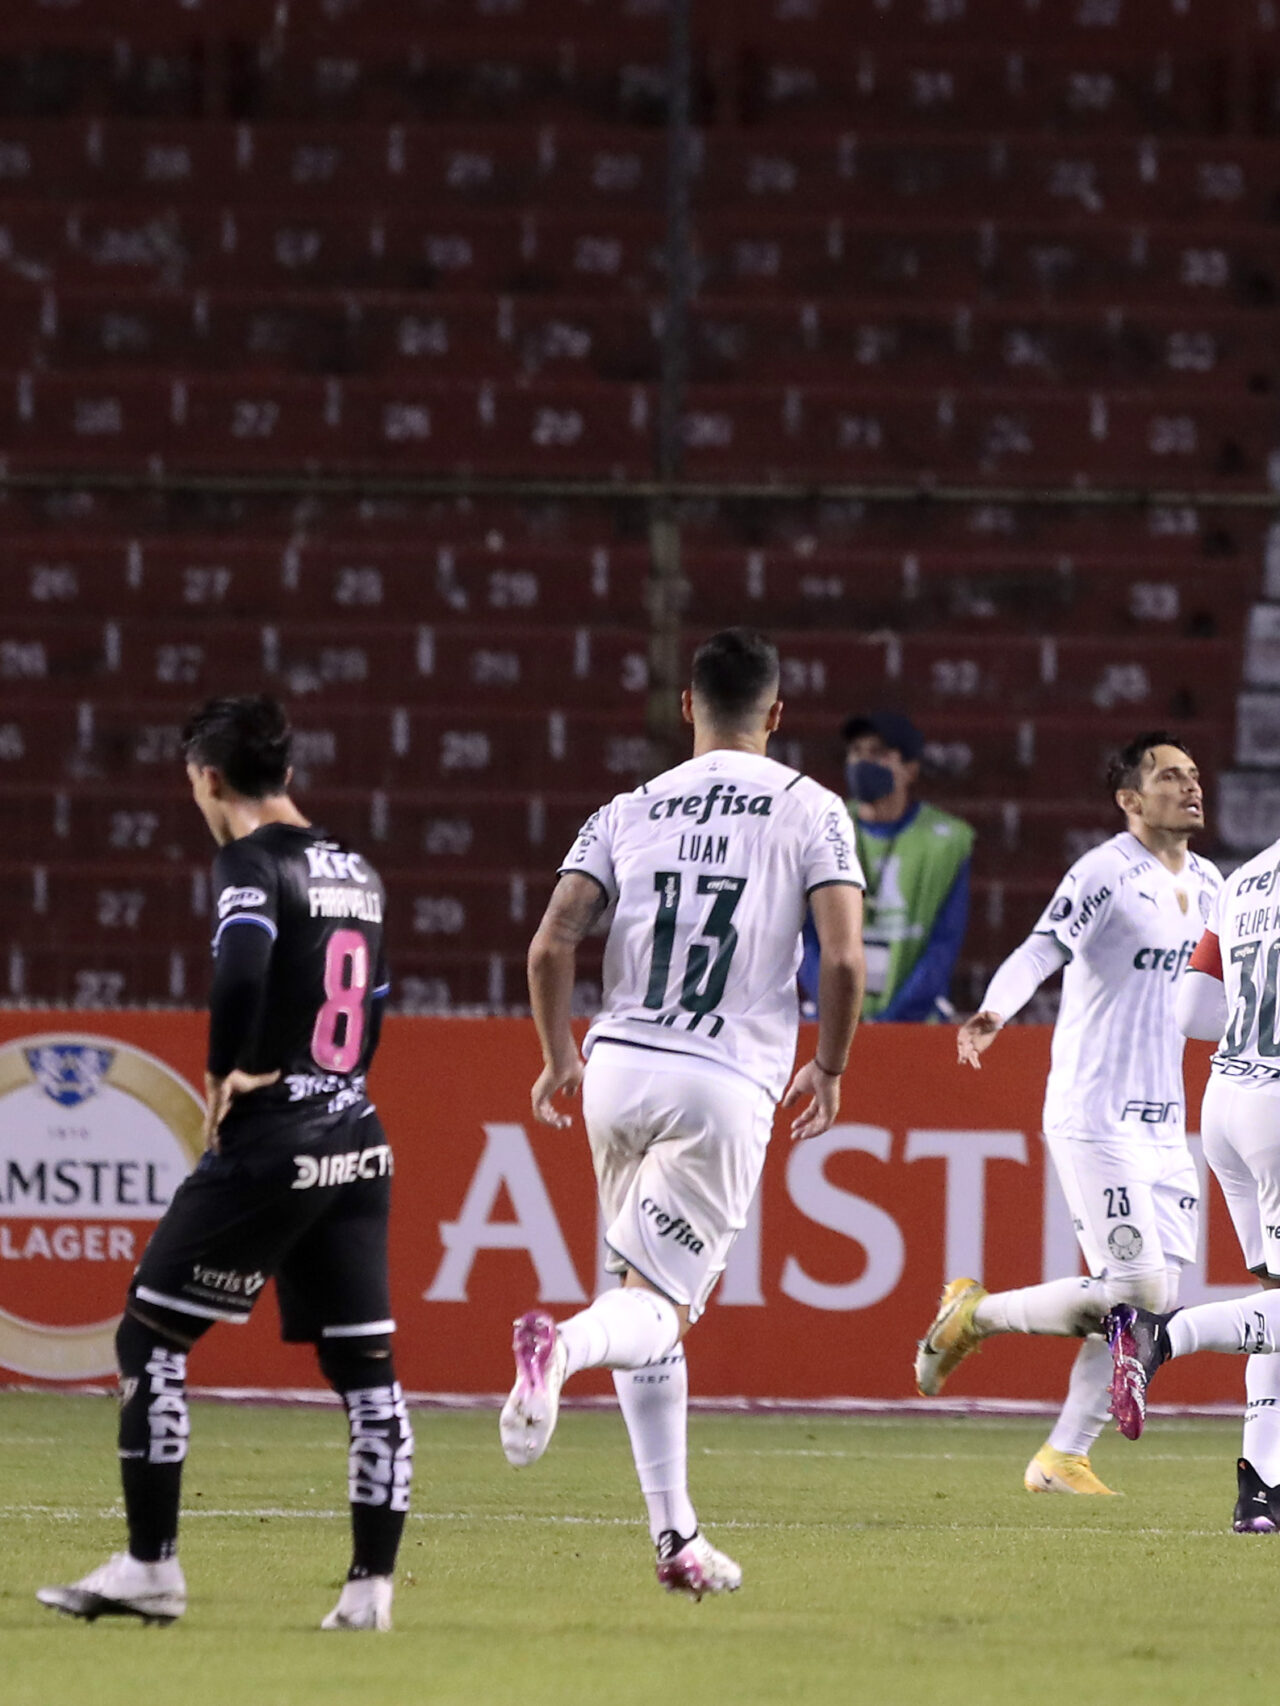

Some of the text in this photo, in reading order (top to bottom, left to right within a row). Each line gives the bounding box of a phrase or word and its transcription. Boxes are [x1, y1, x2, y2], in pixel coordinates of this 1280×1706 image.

[649, 785, 773, 825] crefisa
[304, 847, 368, 884] KFC
[1069, 885, 1112, 938] crefisa
[643, 871, 748, 1014] 13
[1133, 940, 1197, 982] crefi
[310, 928, 370, 1073] 8
[1103, 1187, 1131, 1218] 23
[1, 1226, 135, 1261] LAGER
[641, 1198, 705, 1256] crefisa
